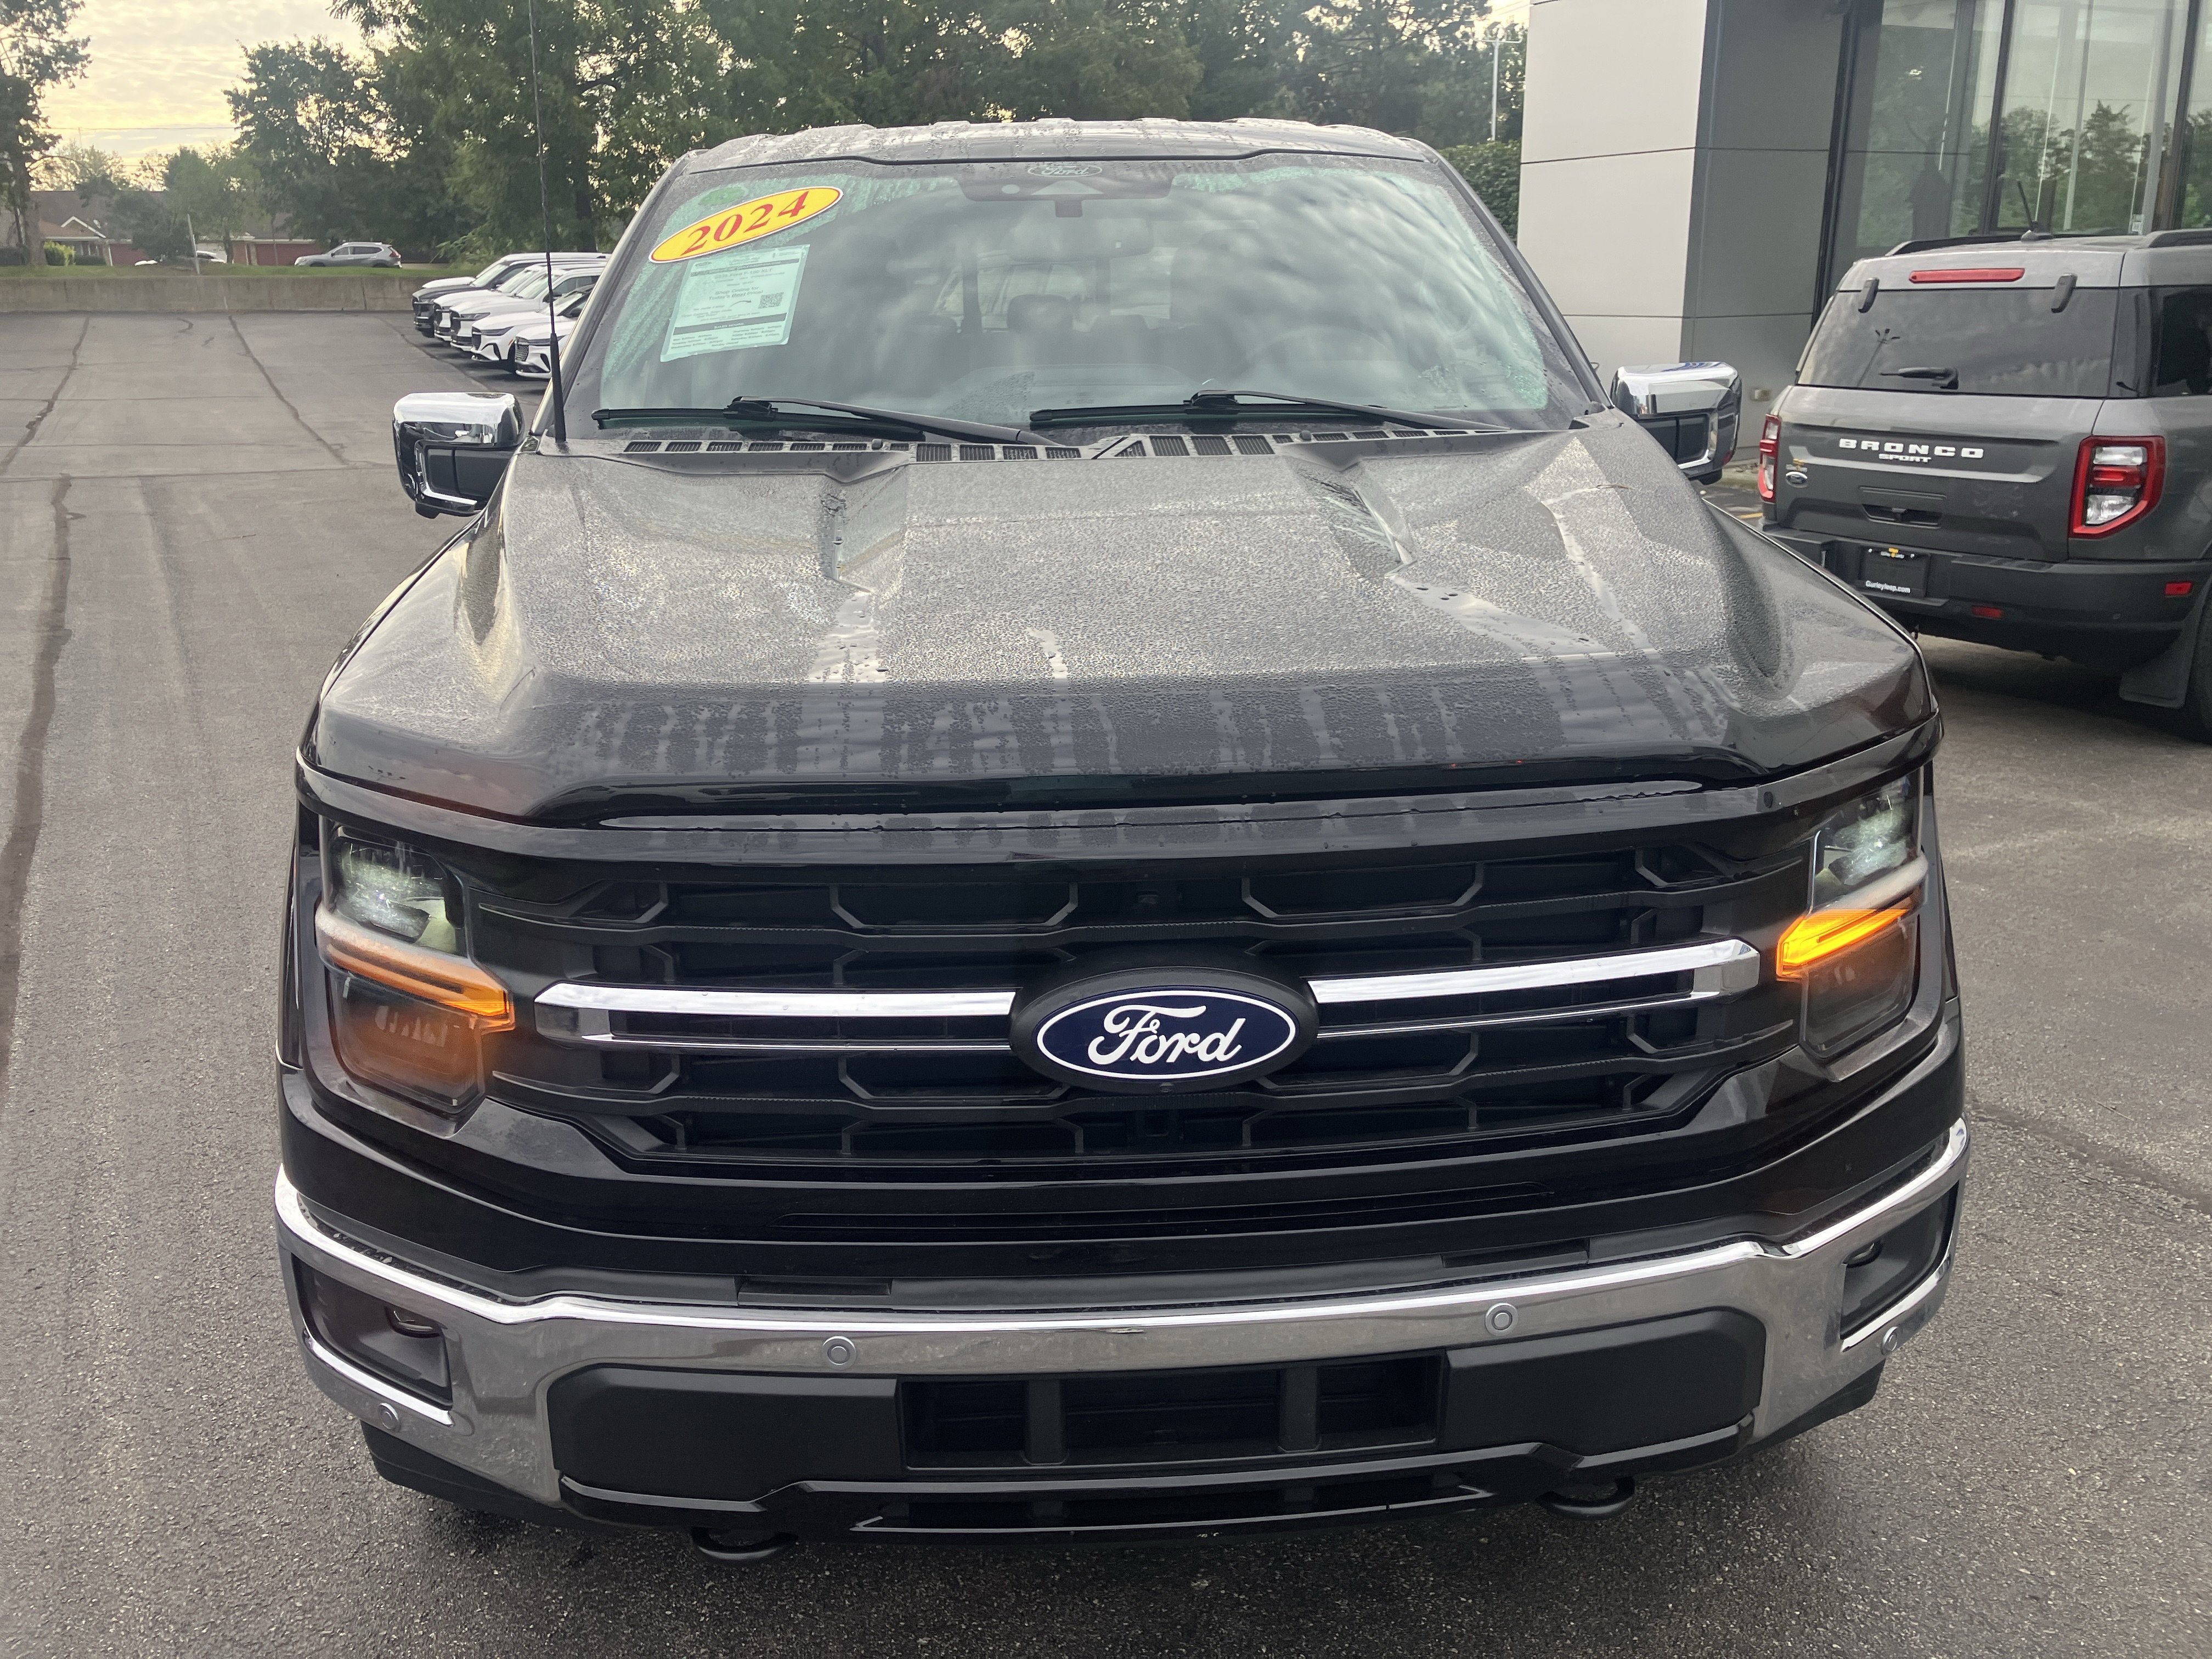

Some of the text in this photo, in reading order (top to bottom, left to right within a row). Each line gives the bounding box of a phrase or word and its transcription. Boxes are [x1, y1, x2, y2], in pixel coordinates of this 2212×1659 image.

[1041, 164, 1090, 175] Ford
[680, 190, 810, 256] 2024
[1839, 438, 1983, 459] BRONCO
[1878, 453, 1932, 463] SPORT
[1087, 1004, 1246, 1065] Ford
